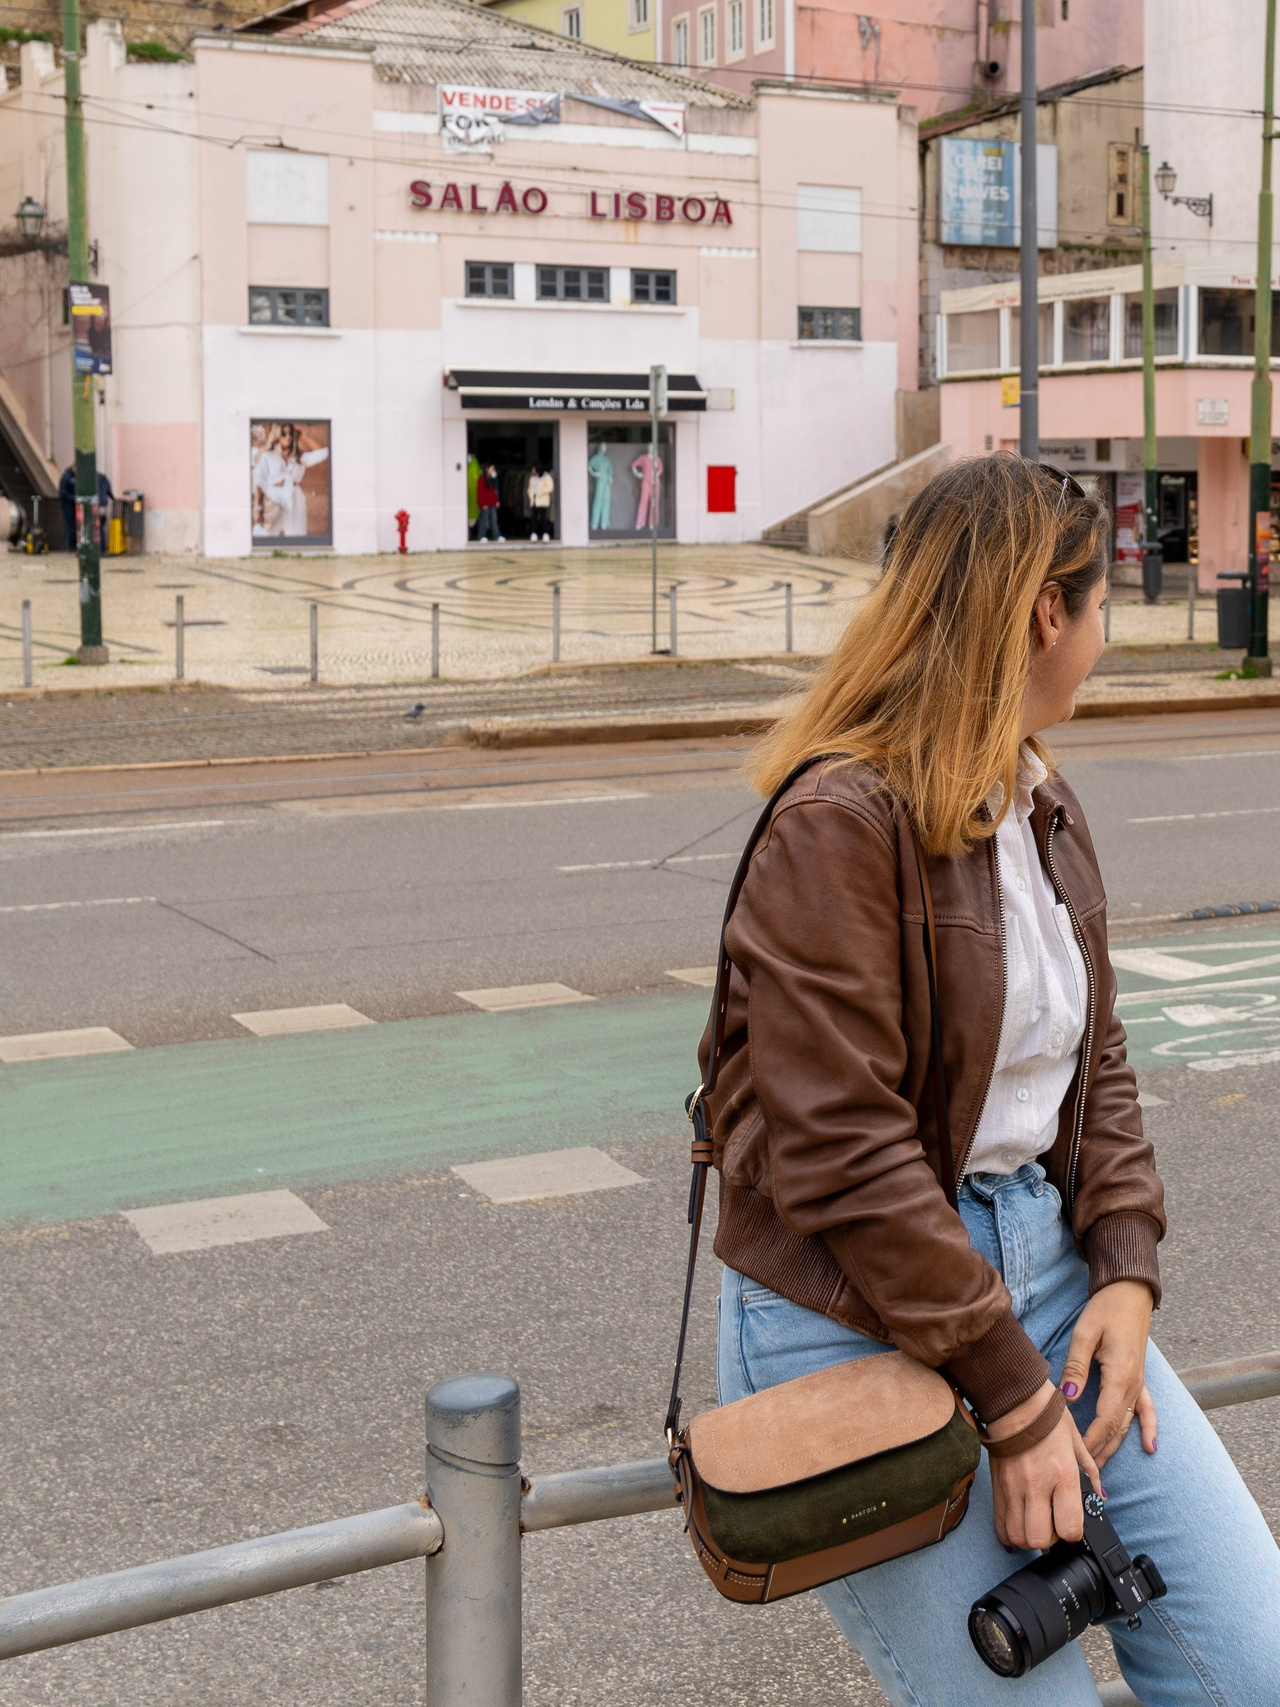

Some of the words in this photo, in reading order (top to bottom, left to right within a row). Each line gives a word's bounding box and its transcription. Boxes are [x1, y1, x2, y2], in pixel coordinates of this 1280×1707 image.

[442, 91, 552, 114] VENDE-S
[410, 179, 548, 215] SALÃO
[590, 191, 733, 225] LISBOA
[529, 396, 564, 409] Lendas
[567, 398, 578, 409] &
